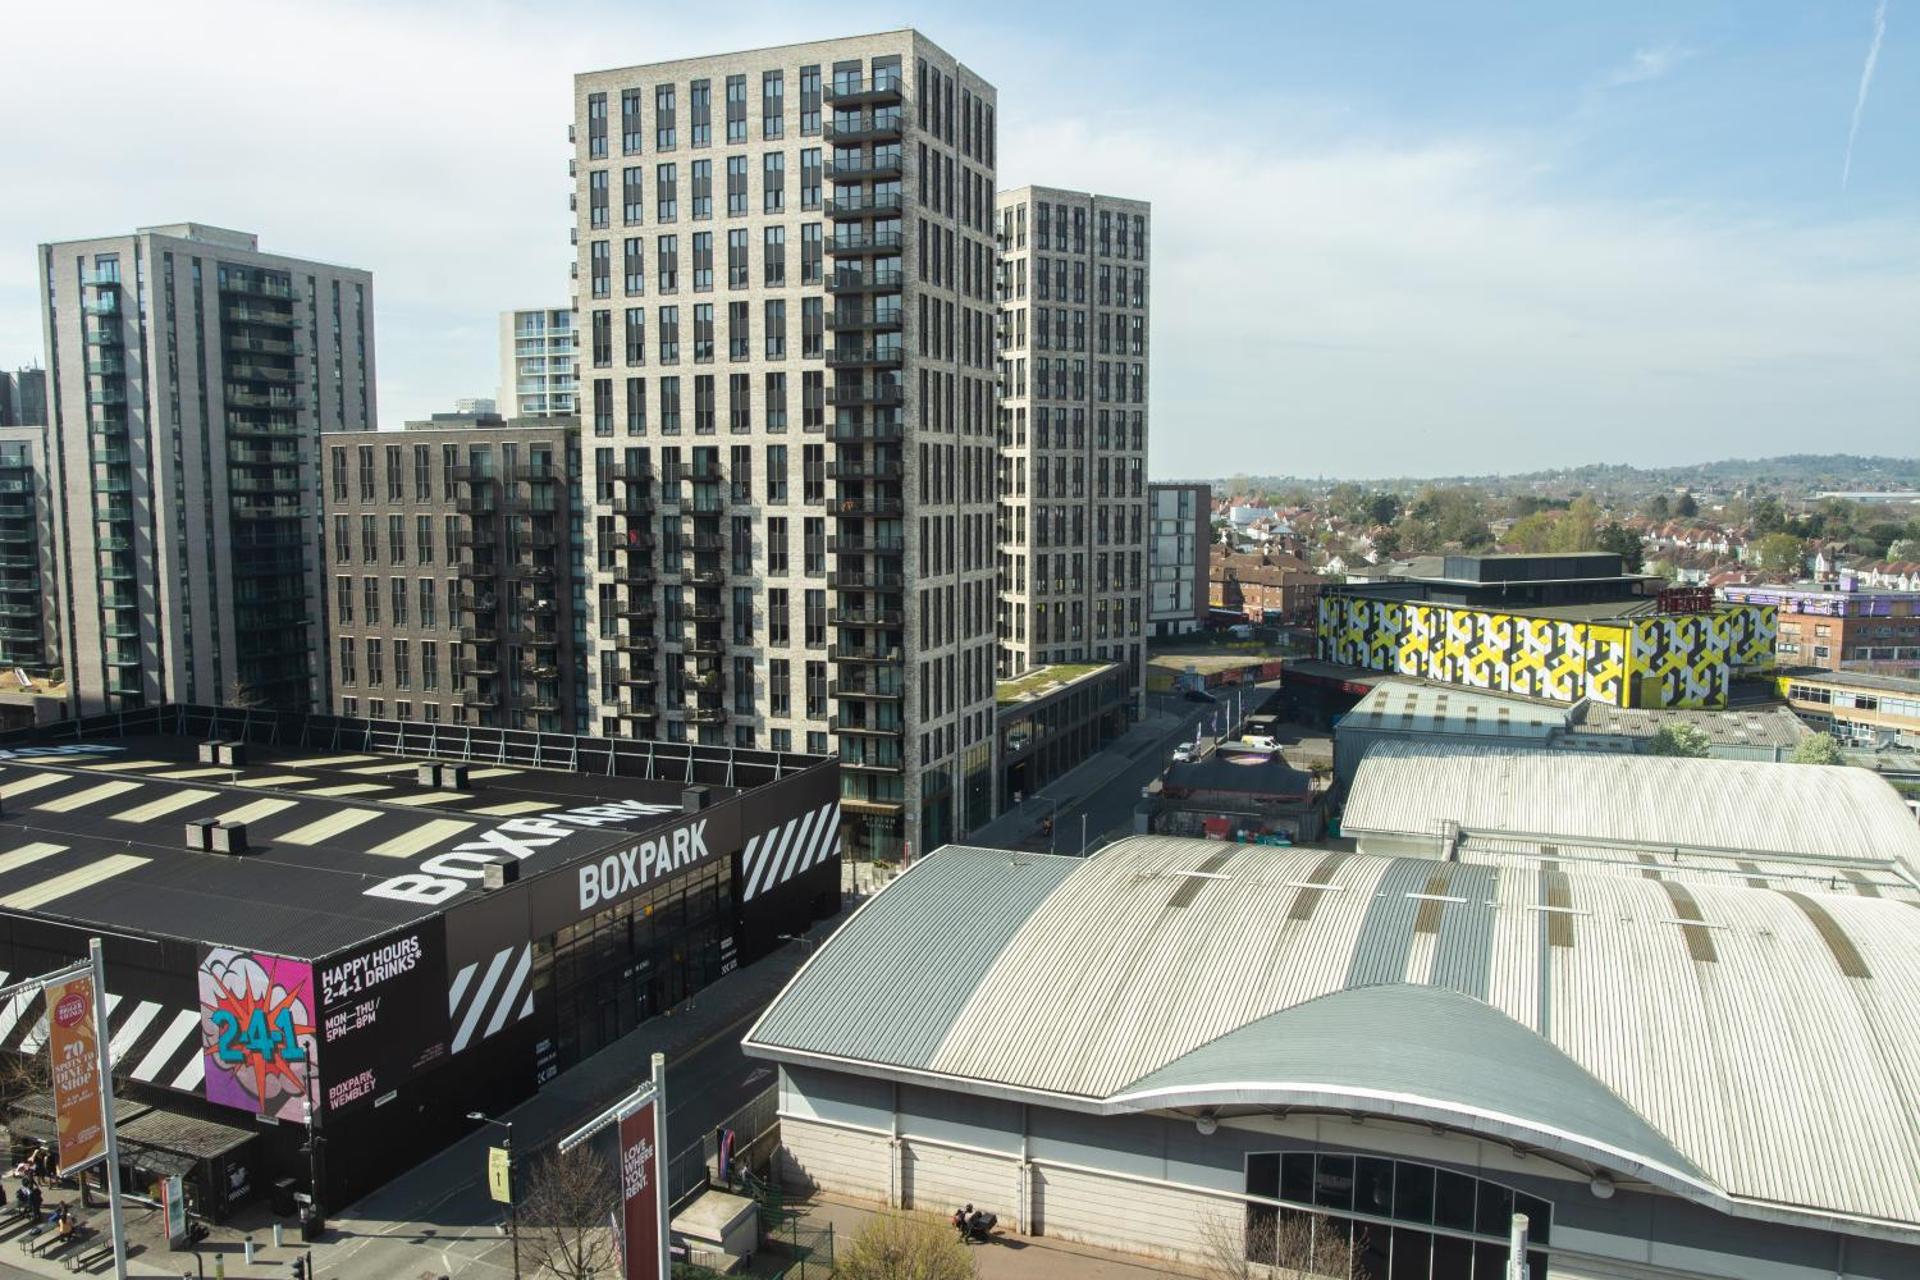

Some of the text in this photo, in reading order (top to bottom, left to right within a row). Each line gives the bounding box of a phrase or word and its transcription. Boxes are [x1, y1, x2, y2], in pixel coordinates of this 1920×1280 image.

[362, 799, 683, 905] BOXPARK
[579, 818, 709, 911] BOXPARK
[322, 935, 419, 988] HAPPY HOURS
[323, 975, 362, 1005] 2-4-1
[64, 1040, 84, 1060] 70
[56, 1066, 83, 1084] DINE
[61, 1073, 91, 1092] SHOP
[329, 1068, 373, 1100] BOXPARK
[330, 1078, 376, 1110] WEMBLEY
[624, 1137, 646, 1163] LOVE
[625, 1144, 654, 1175] WHERE
[625, 1164, 645, 1187] YOU
